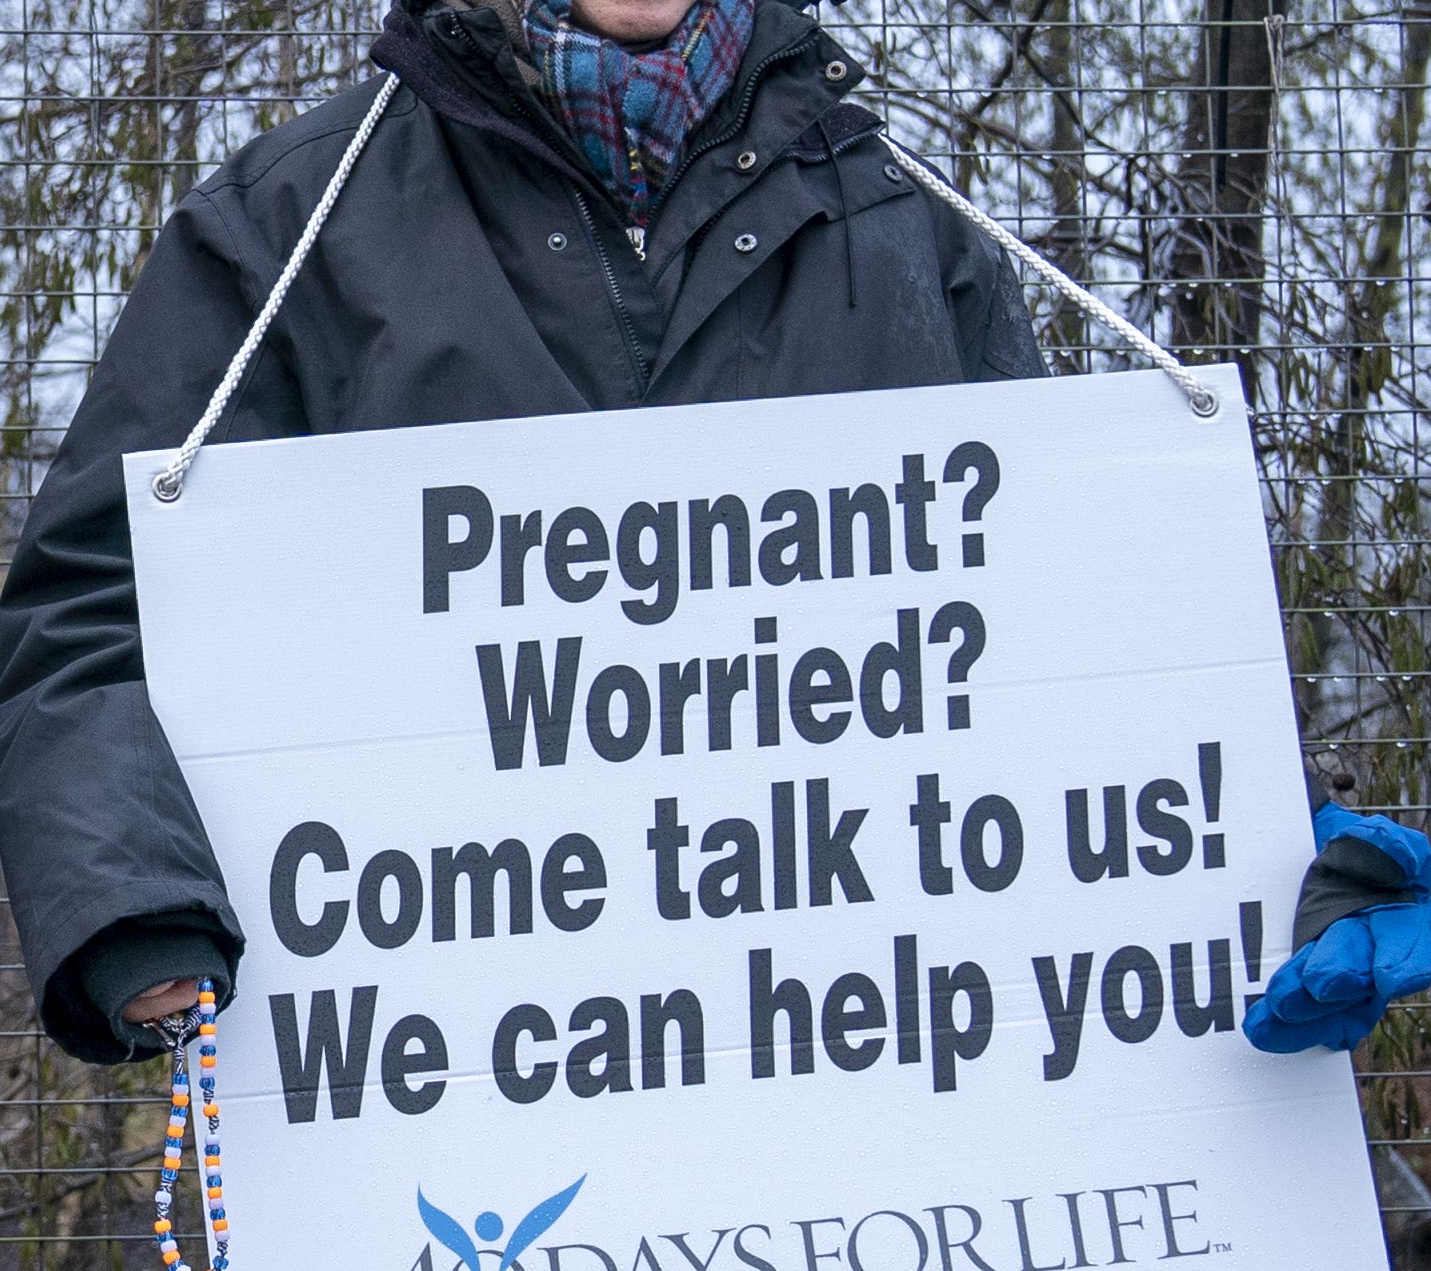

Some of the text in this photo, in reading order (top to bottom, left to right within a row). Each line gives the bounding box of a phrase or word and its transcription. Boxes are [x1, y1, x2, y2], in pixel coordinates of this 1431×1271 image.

[420, 440, 1001, 624] Pregnant?
[475, 600, 988, 771] Worried?
[268, 741, 1228, 959] Come talk to us!
[268, 900, 1264, 1124] We can help you!
